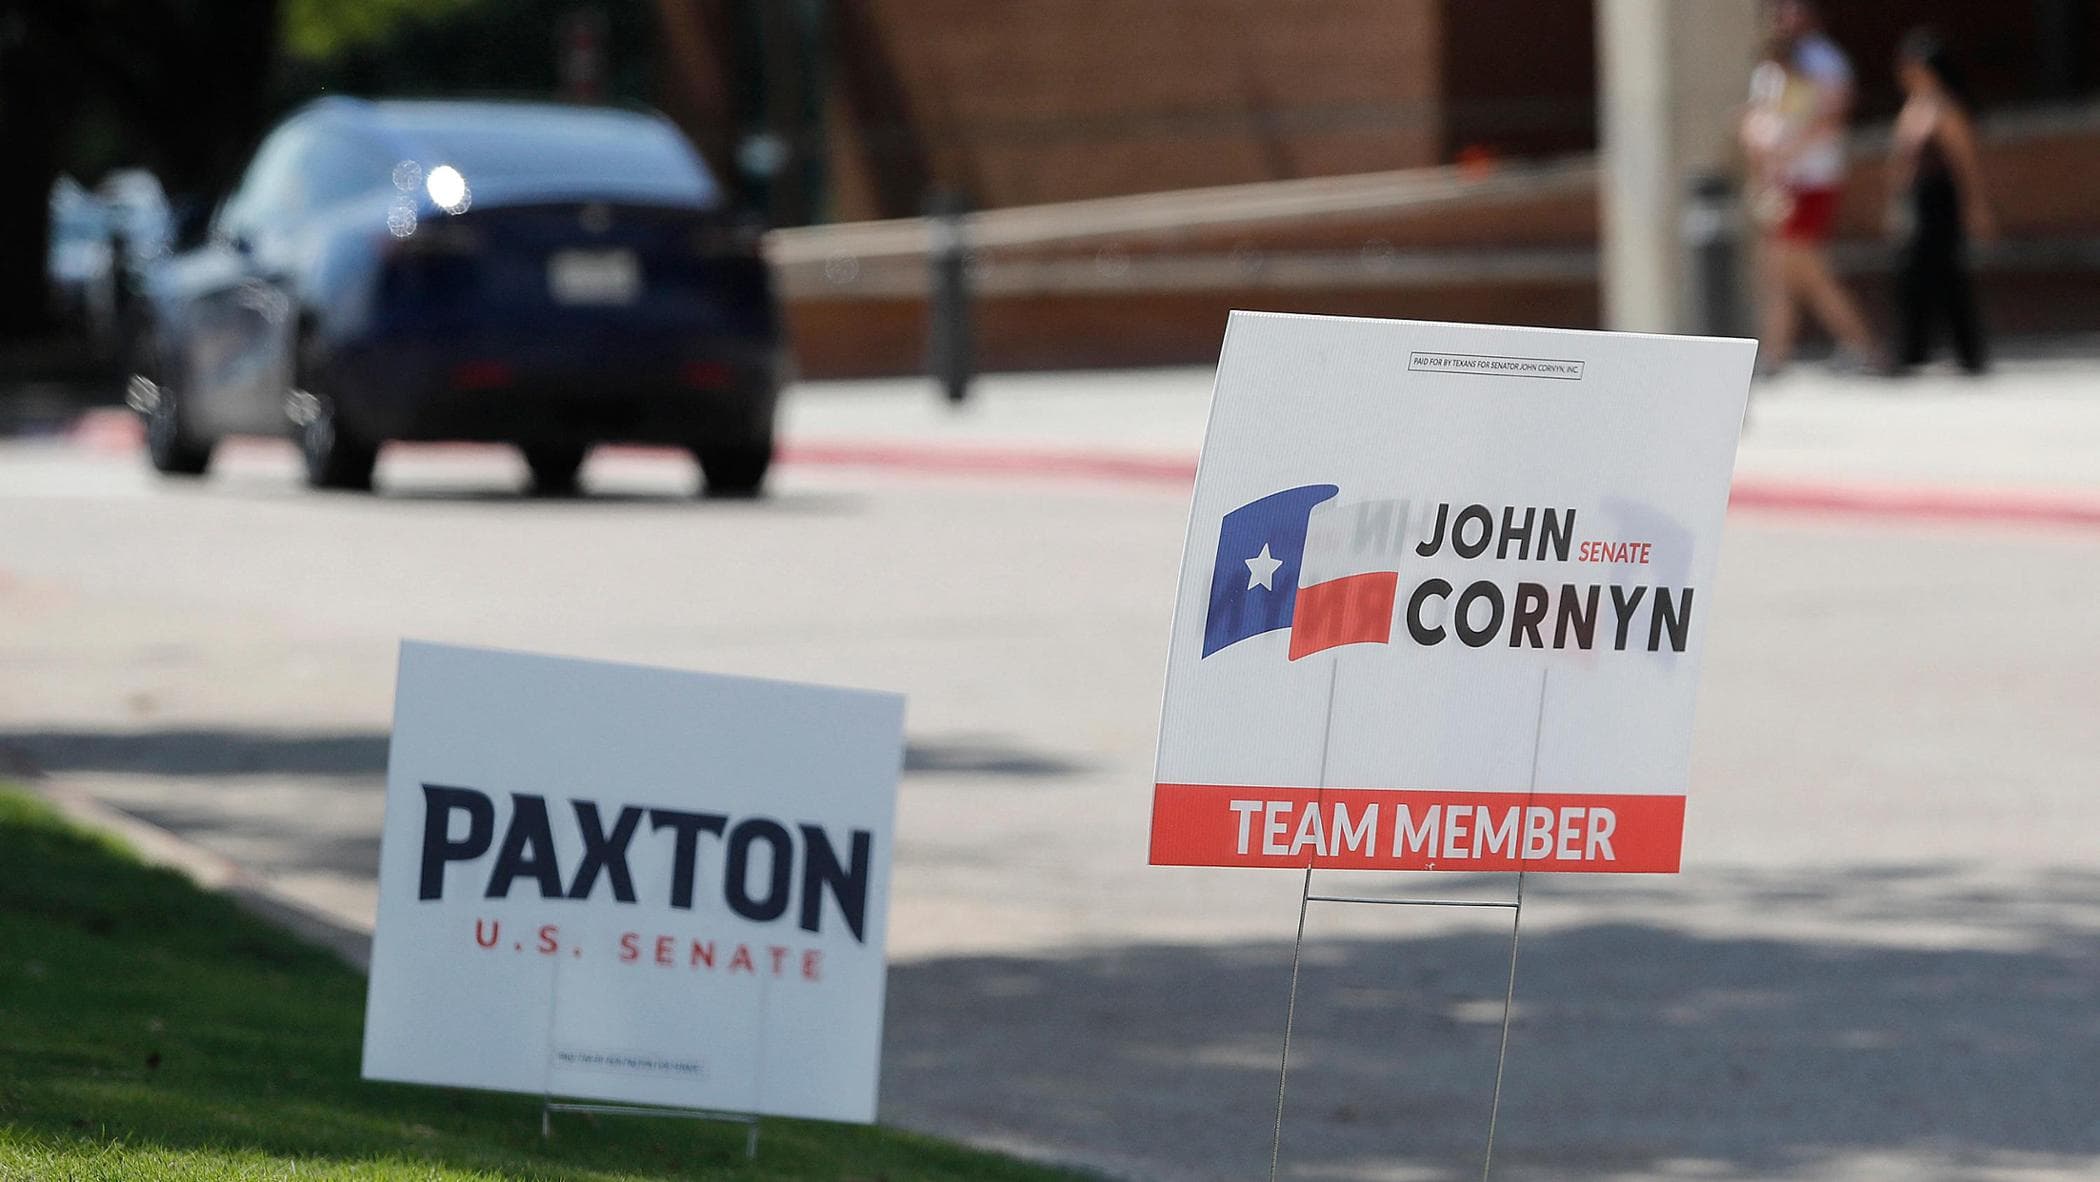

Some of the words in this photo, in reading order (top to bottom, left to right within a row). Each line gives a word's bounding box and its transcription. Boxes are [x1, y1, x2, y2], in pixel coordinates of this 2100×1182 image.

[1413, 357, 1428, 365] PAID
[1429, 358, 1442, 366] FOR
[1443, 359, 1452, 367] BY
[1453, 359, 1477, 368] TEXANS
[1477, 360, 1490, 369] FOR
[1491, 361, 1519, 370] SENATOR
[1519, 362, 1537, 371] JOHN
[1415, 503, 1576, 562] JOHN
[1578, 541, 1652, 564] SENATE
[1406, 578, 1694, 652] CORNYN
[1229, 800, 1378, 857] TEAM
[1393, 803, 1616, 861] MEMBER
[419, 784, 871, 945] PAXTON
[475, 918, 582, 958] U.S.
[620, 931, 823, 981] SENATE
